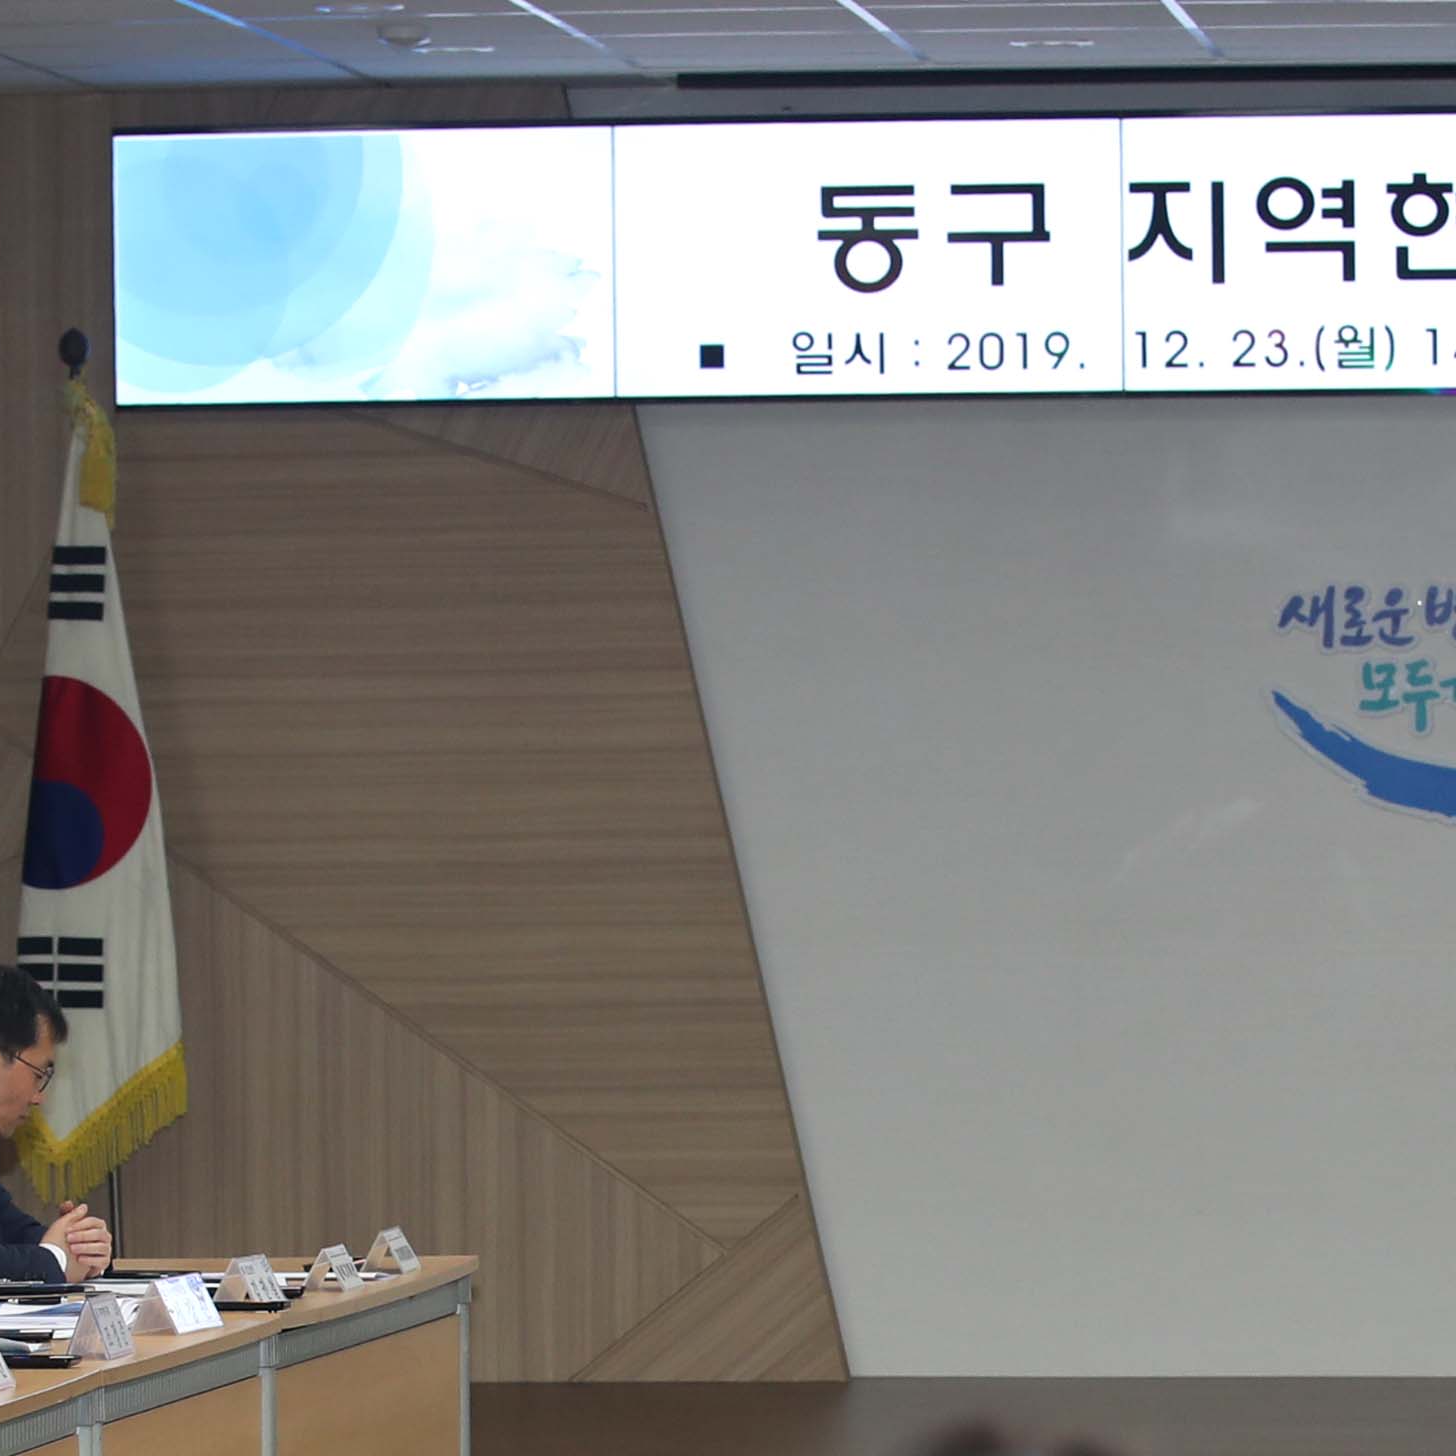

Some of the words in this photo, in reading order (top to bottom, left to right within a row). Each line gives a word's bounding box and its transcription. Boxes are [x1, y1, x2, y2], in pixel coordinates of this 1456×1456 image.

[816, 182, 1052, 294] 동구
[791, 330, 886, 376] 일시
[947, 331, 1087, 371] 2019.
[1135, 330, 1206, 369] 12.
[1232, 323, 1396, 372] 23.(월)
[1278, 584, 1415, 649] 새로운
